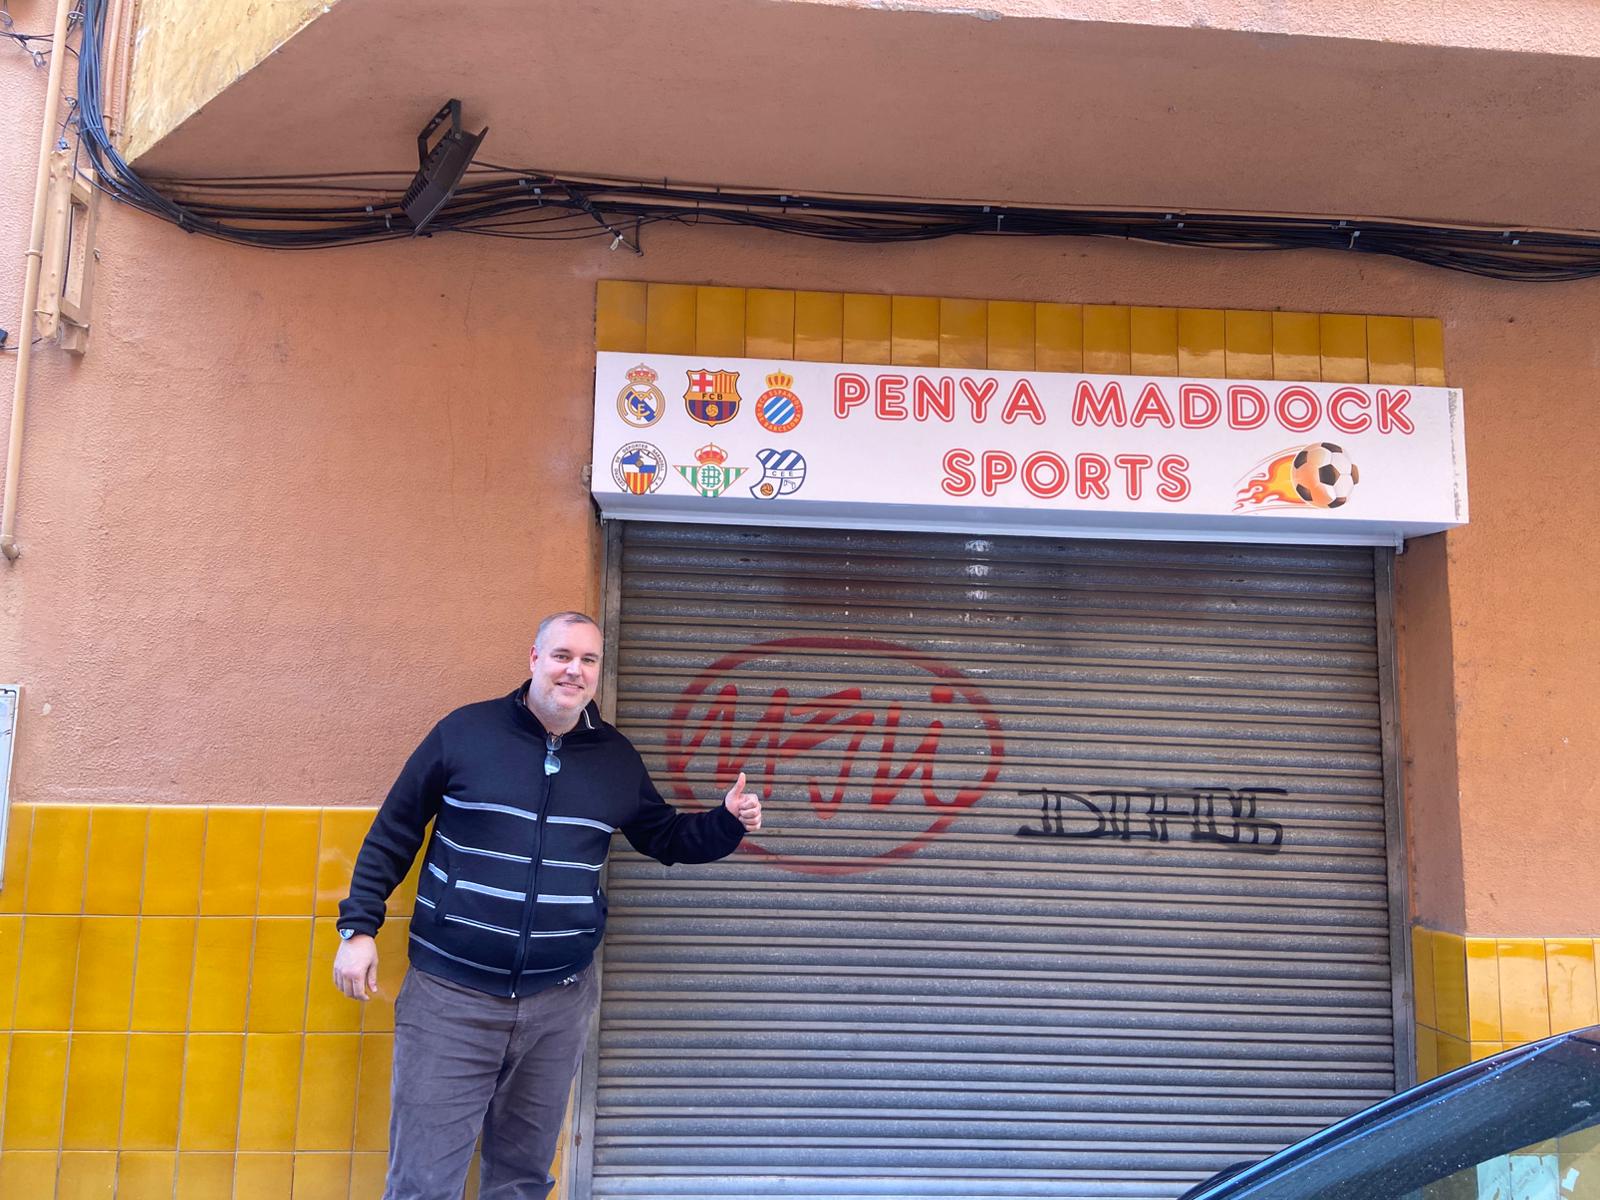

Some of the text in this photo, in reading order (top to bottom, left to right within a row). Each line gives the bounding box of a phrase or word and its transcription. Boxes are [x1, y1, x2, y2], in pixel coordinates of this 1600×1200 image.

[702, 393, 723, 401] FCB
[834, 373, 1415, 435] PENYA MADDOCK
[942, 448, 1192, 502] SPORTS
